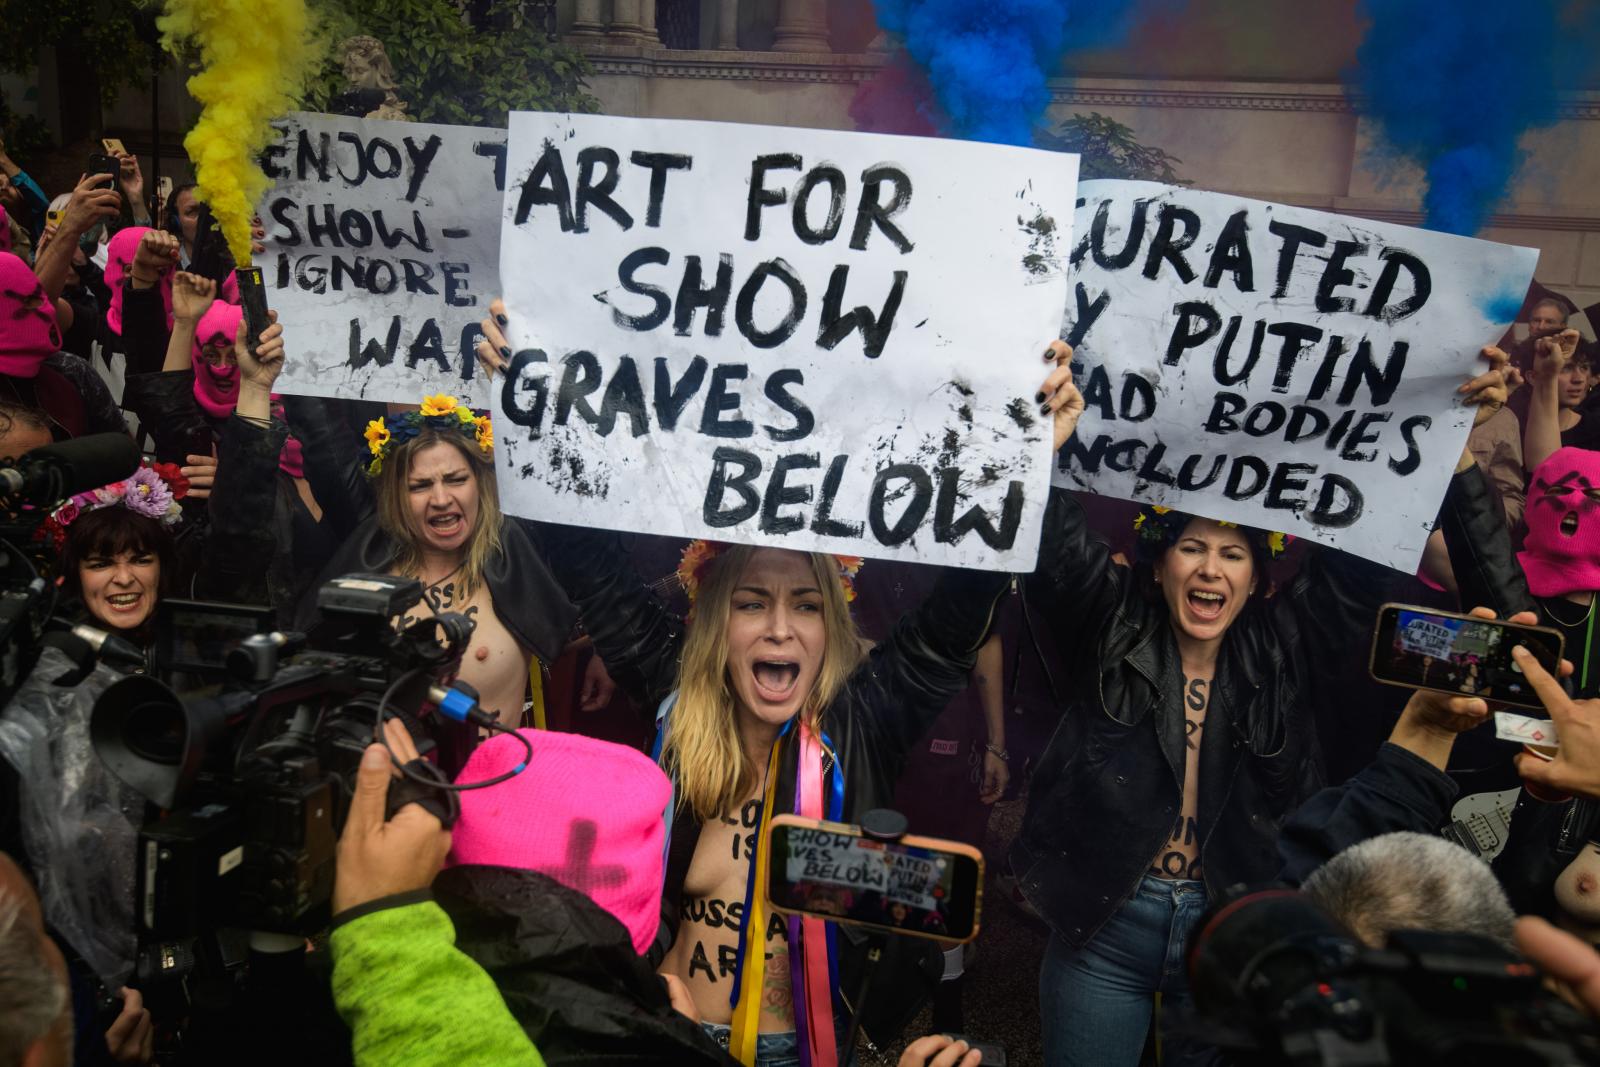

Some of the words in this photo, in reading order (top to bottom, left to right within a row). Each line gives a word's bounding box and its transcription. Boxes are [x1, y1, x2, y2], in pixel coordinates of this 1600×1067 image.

[258, 122, 442, 202] ENJOY
[515, 147, 692, 234] ART
[744, 152, 915, 254] FOR
[277, 253, 477, 307] IGNORE
[593, 246, 909, 359] SHOW
[501, 347, 815, 441] GRAVES
[1163, 300, 1410, 407] PUTIN
[1072, 364, 1157, 423] AD
[1204, 391, 1432, 476] BODIES
[703, 446, 1025, 551] BELOW
[1058, 432, 1365, 528] NCLUDED
[680, 898, 789, 943] RUSSA
[803, 861, 884, 887] BELOW
